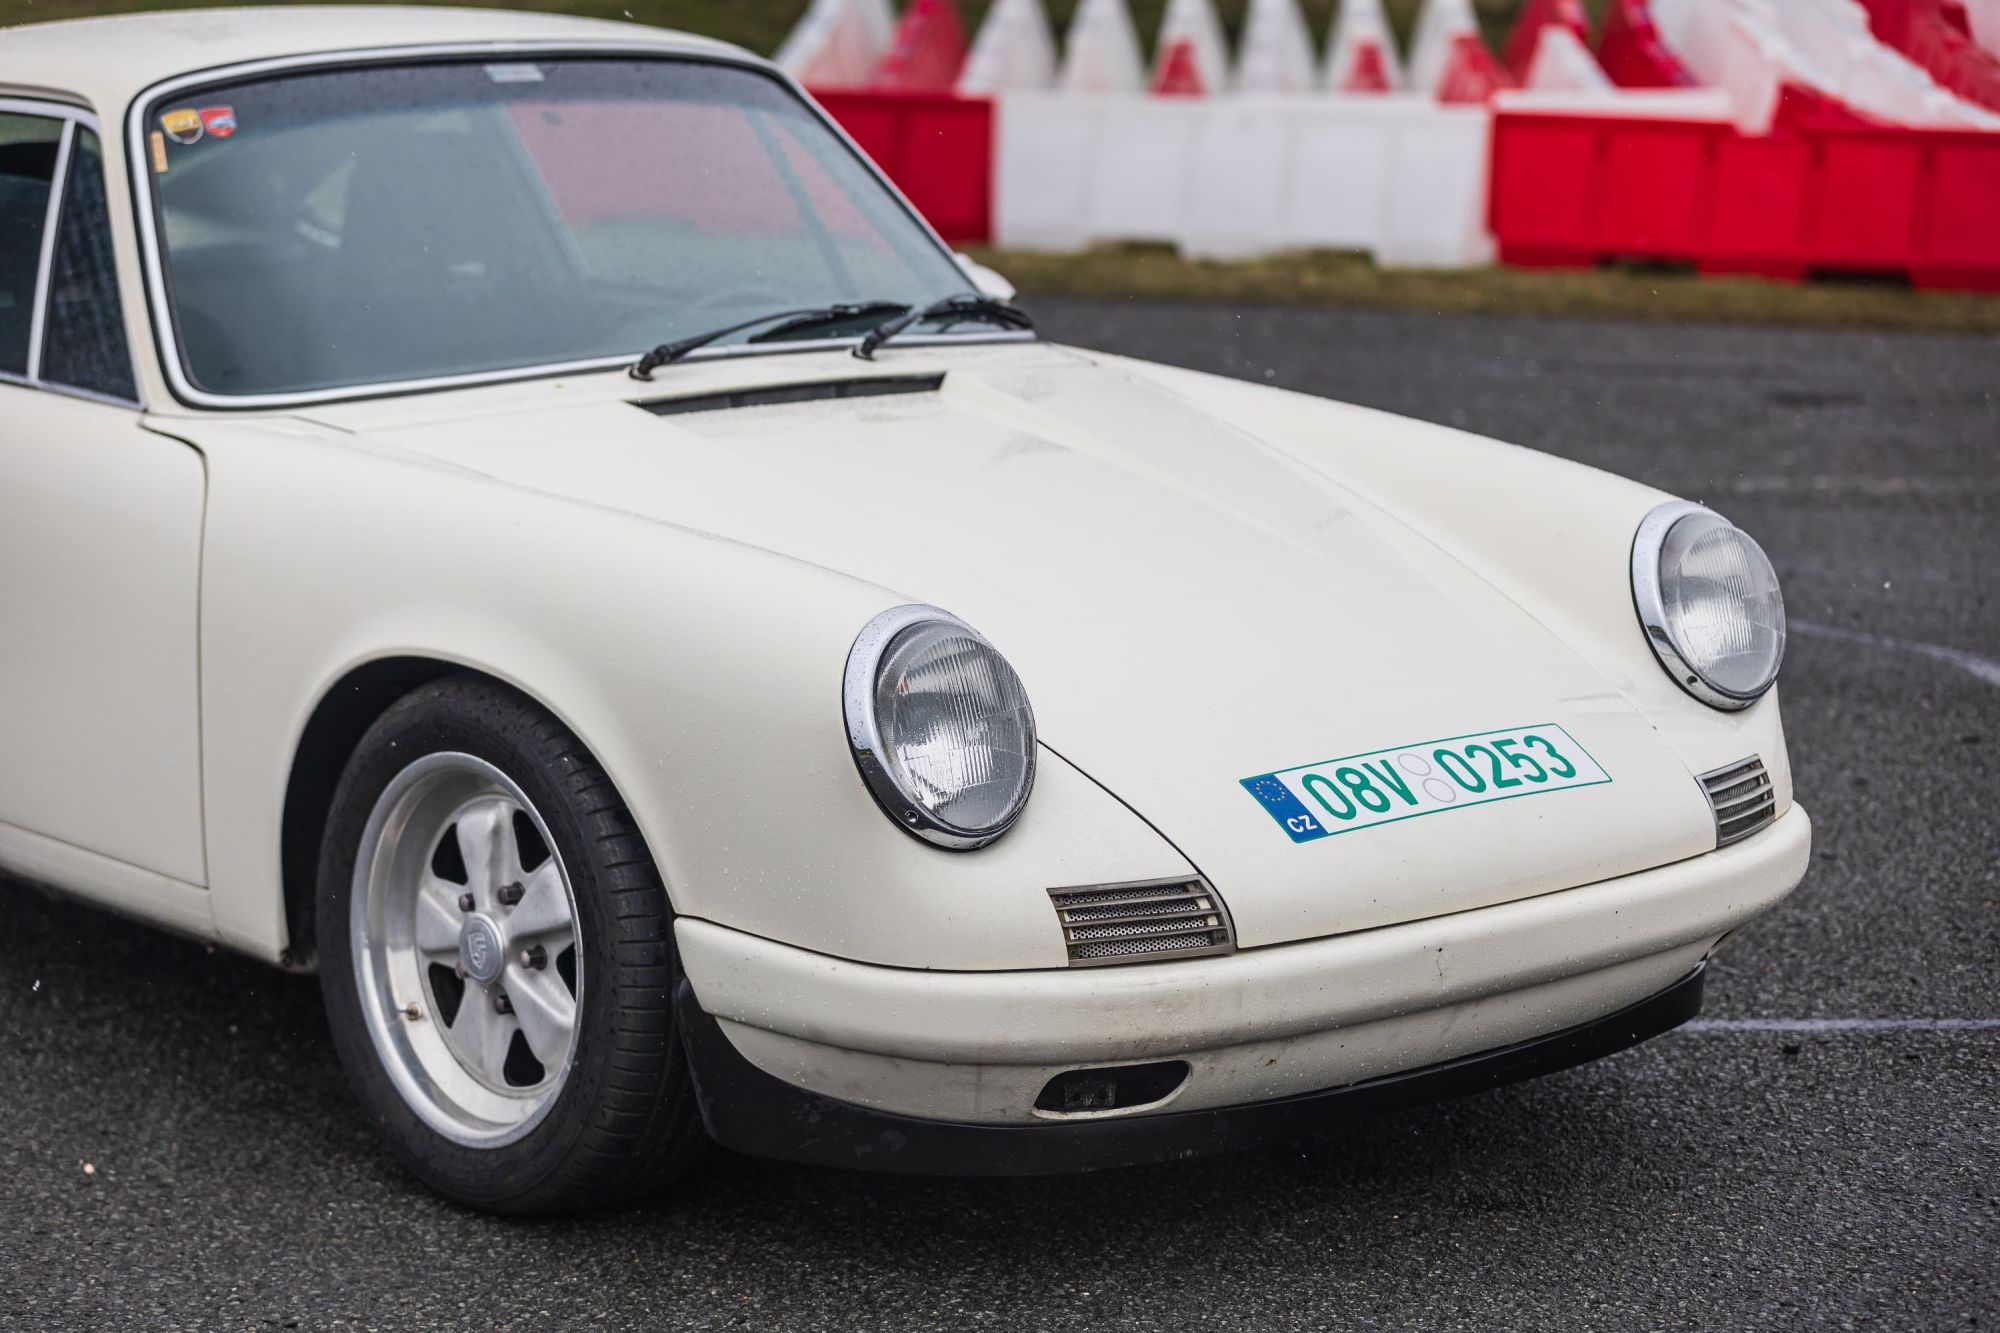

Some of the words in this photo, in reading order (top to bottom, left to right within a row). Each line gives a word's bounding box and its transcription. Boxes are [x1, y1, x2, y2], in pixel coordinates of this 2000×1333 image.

[1301, 759, 1419, 820] 08V
[1432, 735, 1577, 793] 0253
[1286, 814, 1318, 833] CZ
